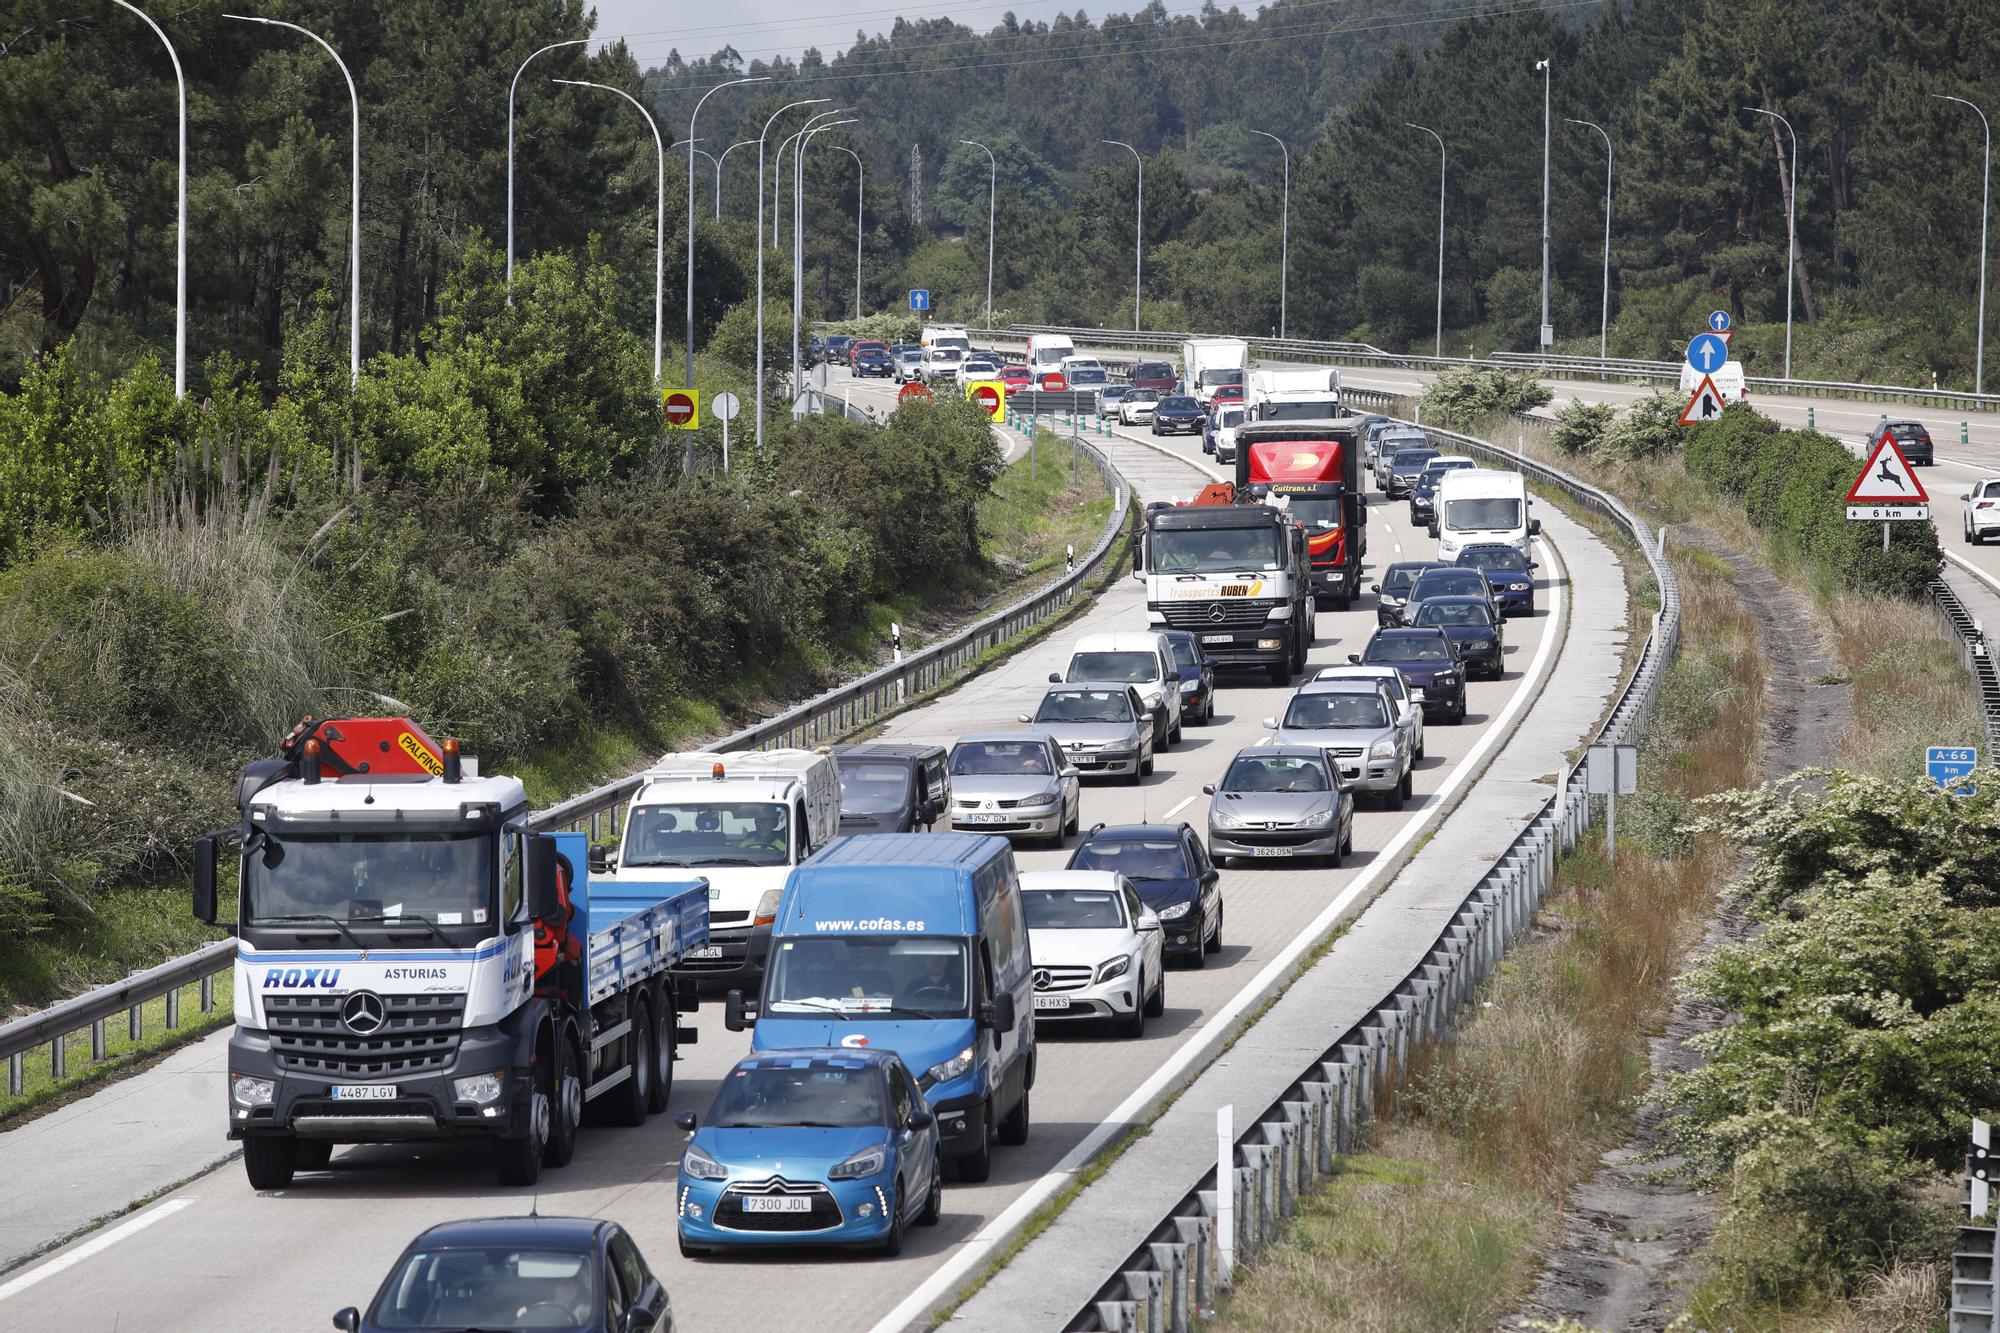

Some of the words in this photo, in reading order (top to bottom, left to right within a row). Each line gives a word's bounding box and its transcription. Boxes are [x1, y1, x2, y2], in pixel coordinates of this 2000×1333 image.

[1272, 484, 1306, 492] Guttrans,
[1873, 509, 1880, 518] 6
[1886, 509, 1902, 518] km
[1220, 585, 1248, 596] RUBEN
[401, 736, 444, 777] PALFING
[1936, 750, 1968, 760] A-66
[816, 918, 925, 931] www.cofas.es
[263, 968, 340, 988] ROXU
[384, 968, 446, 979] ASTURIAS
[1050, 998, 1068, 1007] HXS
[341, 1088, 368, 1098] 4487
[372, 1088, 394, 1098] LGV
[752, 1199, 781, 1210] 7300
[786, 1199, 808, 1210] JDL
